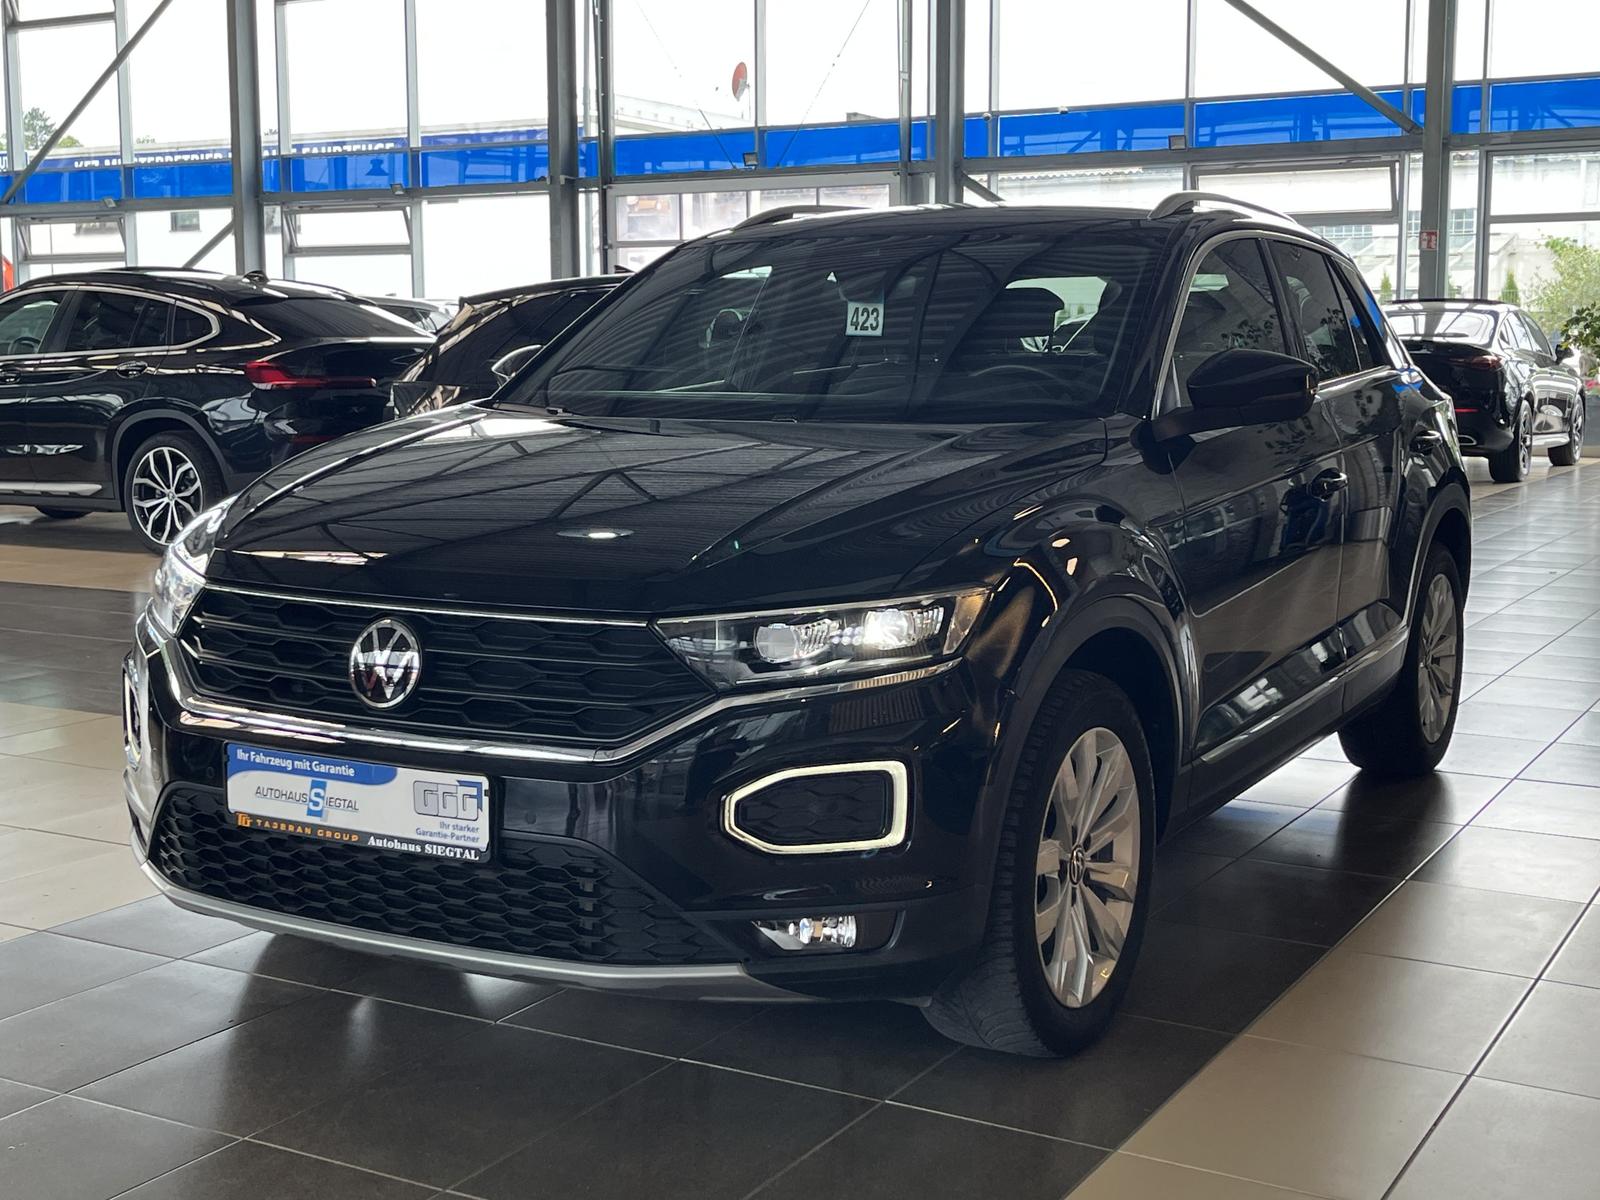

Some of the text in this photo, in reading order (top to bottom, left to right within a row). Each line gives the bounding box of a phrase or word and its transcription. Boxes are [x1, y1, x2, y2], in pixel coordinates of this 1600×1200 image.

[850, 306, 880, 331] 423
[236, 748, 355, 777] Ihr Fahrzeug mit Garantie
[255, 786, 360, 812] AUTOHAUS SIEGTAL
[317, 829, 359, 842] GROUP
[415, 827, 480, 843] Garantie-Partner
[439, 821, 480, 833] Ihr starker
[367, 836, 479, 861] Autohaus SIEGTAL
